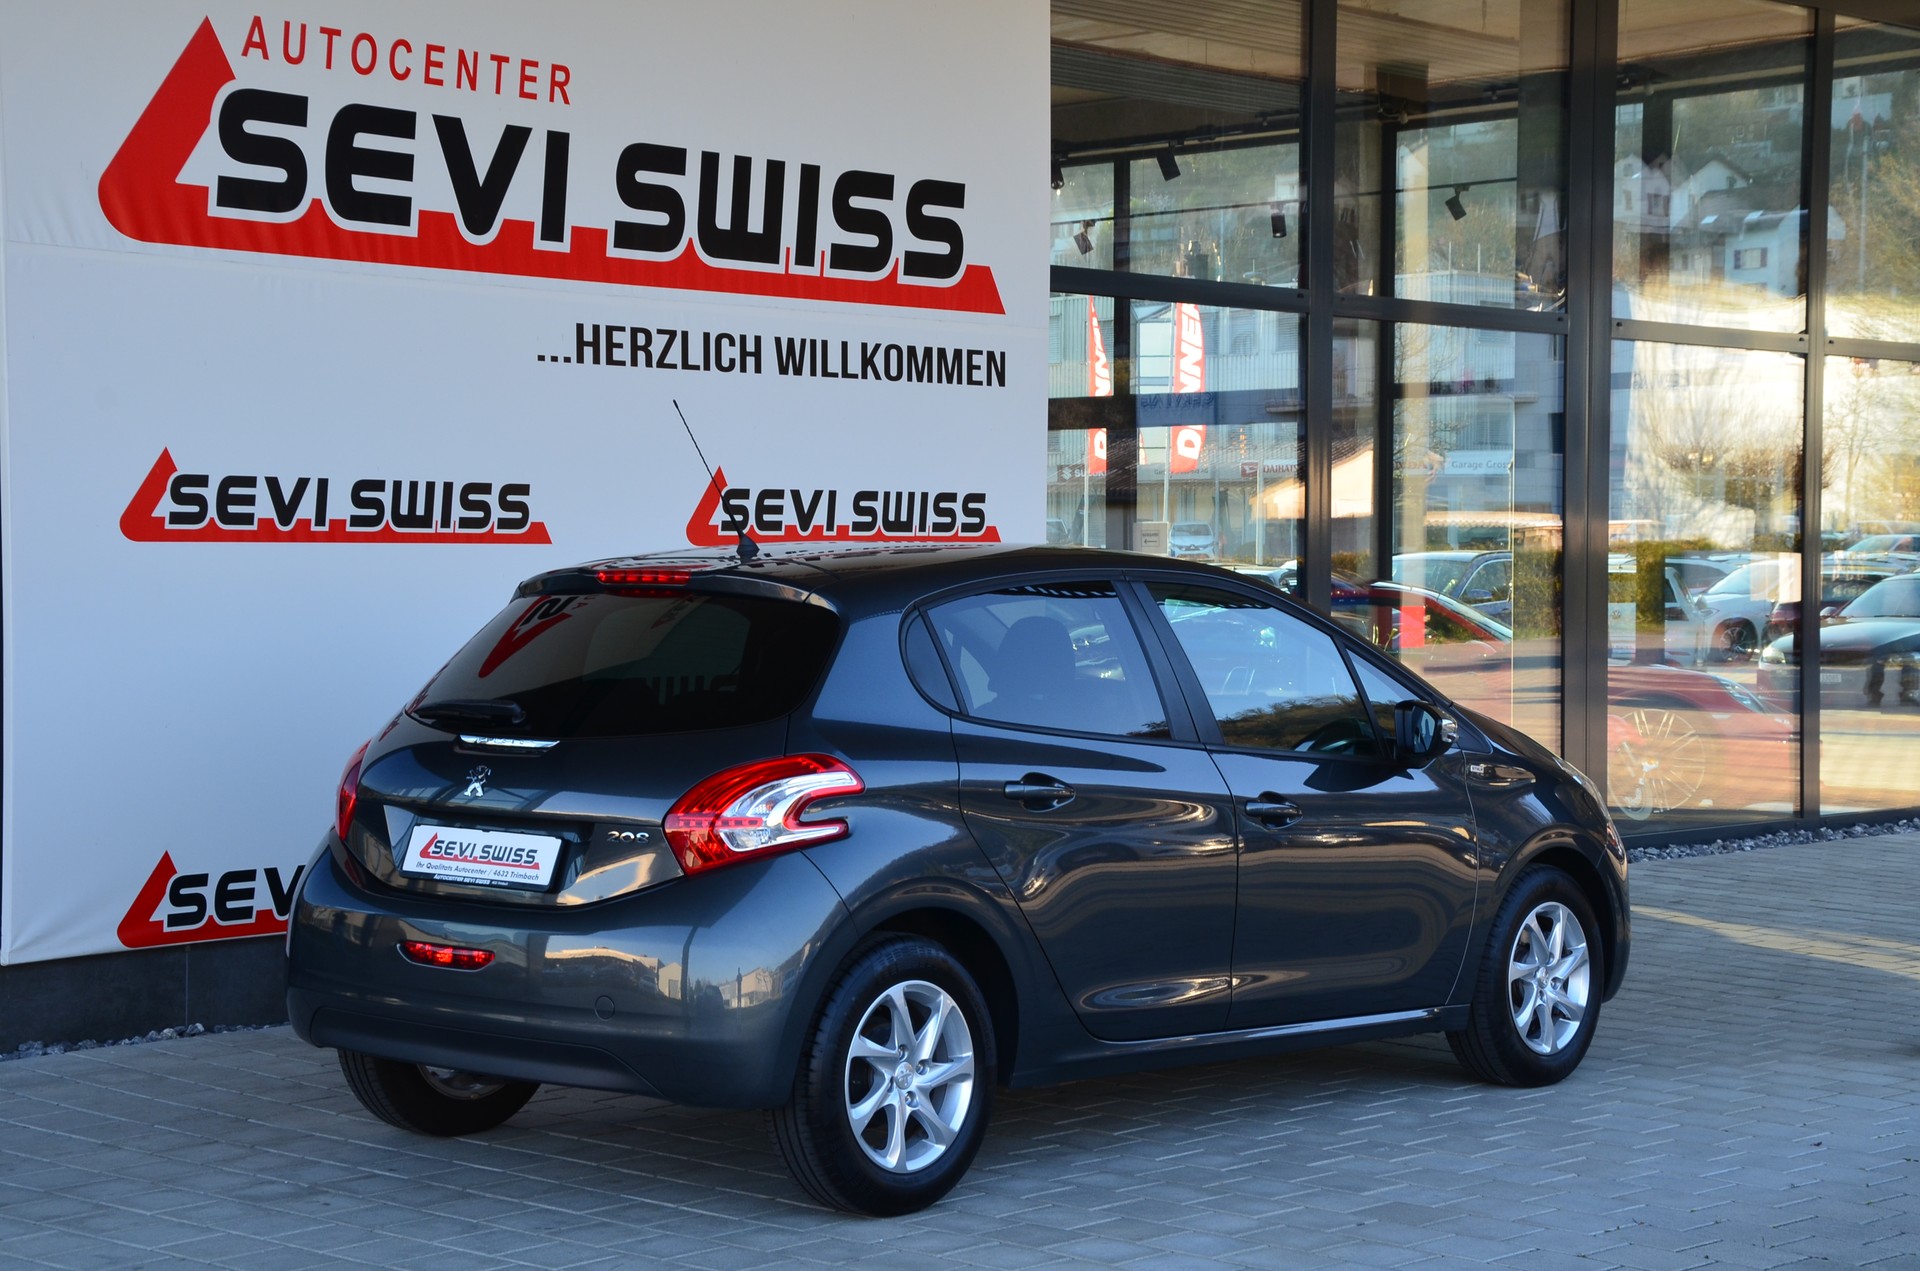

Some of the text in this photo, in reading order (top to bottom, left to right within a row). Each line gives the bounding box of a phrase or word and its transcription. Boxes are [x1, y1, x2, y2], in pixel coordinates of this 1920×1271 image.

[241, 15, 571, 105] AUTOCENTER
[216, 88, 966, 279] SEVI SWISS
[774, 336, 1006, 387] WILLKOMMEN
[1451, 461, 1483, 471] Garage
[168, 474, 530, 530] SEVI SWISS
[721, 488, 986, 533] SEVI SWISS
[431, 840, 538, 864] SEVI SWISS
[606, 830, 649, 843] 208
[416, 861, 425, 869] Ihr
[454, 865, 487, 876] Autocenter
[493, 869, 509, 878] 4632
[510, 871, 539, 881] Trimbach
[167, 865, 306, 927] SEV
